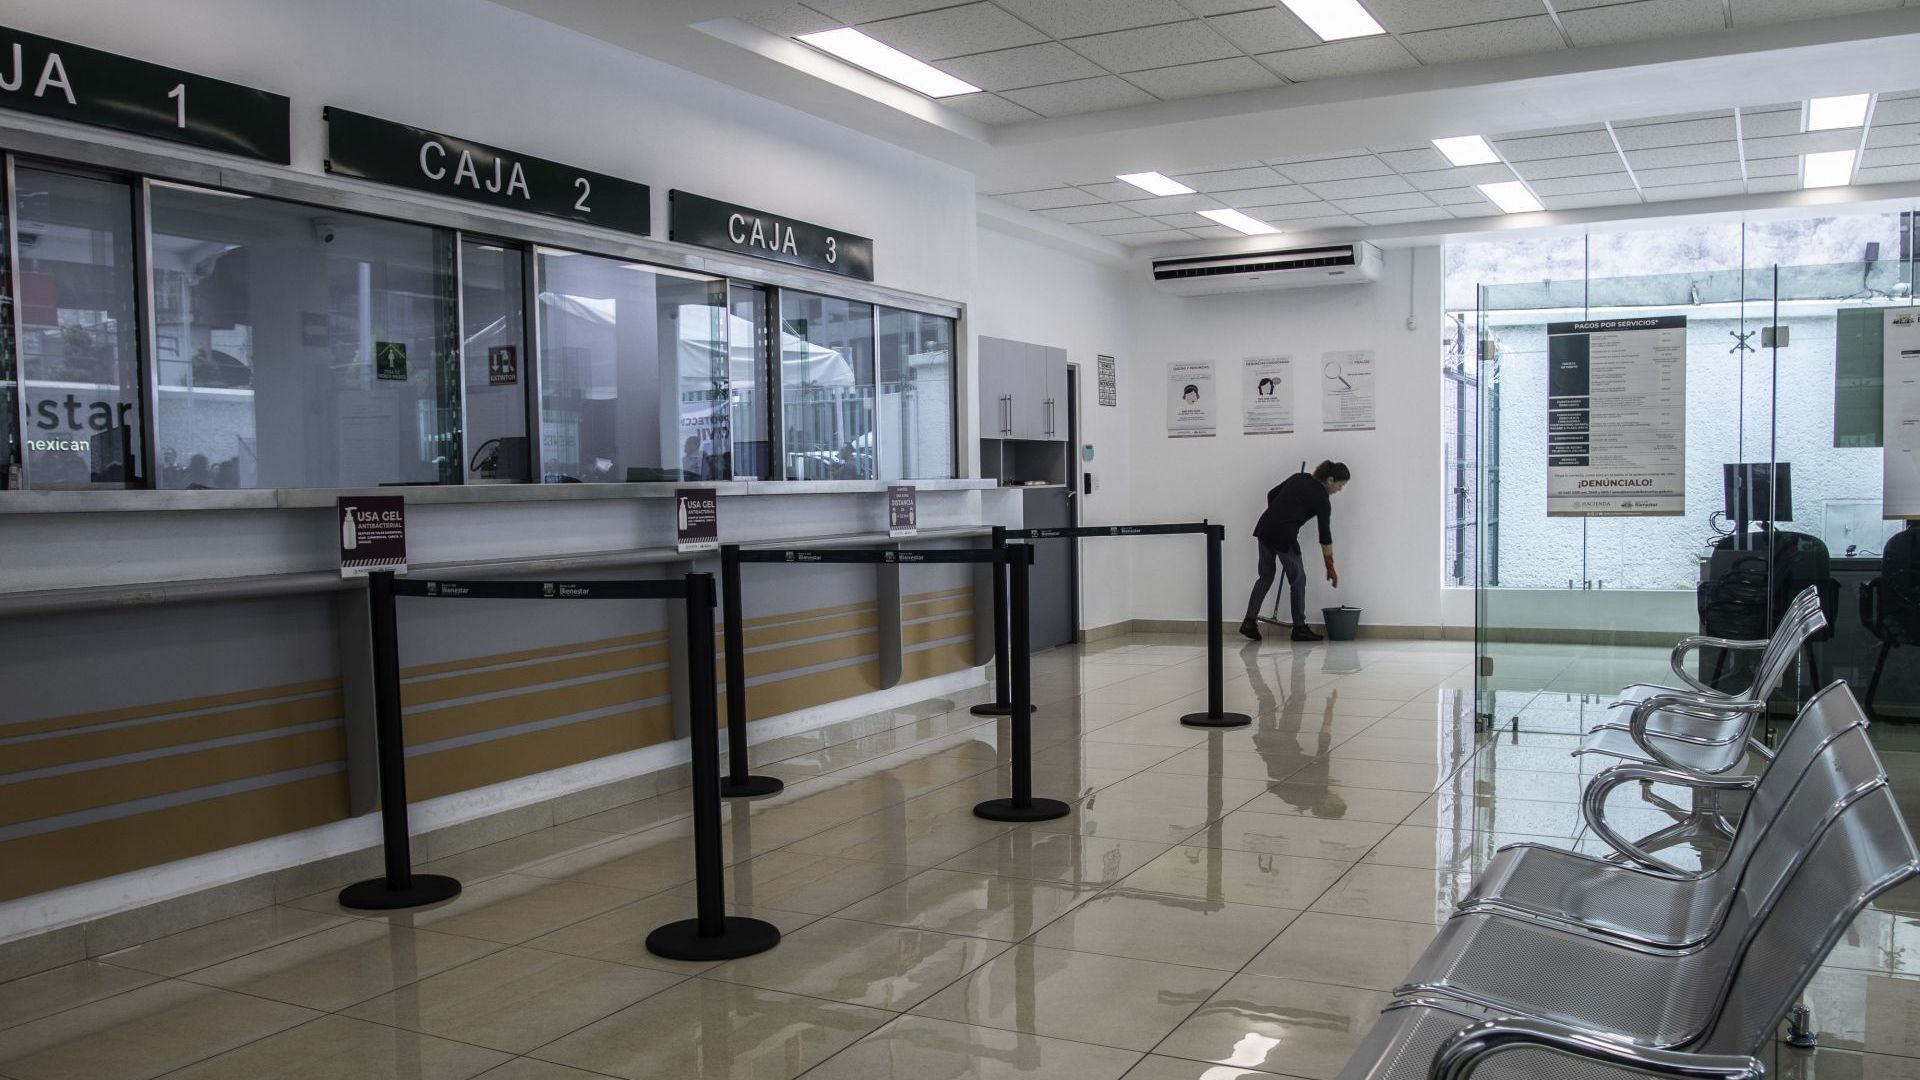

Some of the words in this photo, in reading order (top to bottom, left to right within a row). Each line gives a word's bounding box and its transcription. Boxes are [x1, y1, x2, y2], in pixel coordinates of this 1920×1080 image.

[0, 43, 77, 105] JA
[167, 83, 187, 128] 1
[419, 141, 531, 200] CAJA
[574, 177, 592, 212] 2
[728, 213, 798, 257] CAJA
[825, 236, 837, 264] 3
[1574, 322, 1600, 330] PAGOS
[1578, 477, 1653, 489] ¡DENÚNCIALO!
[687, 500, 701, 509] USA
[702, 500, 716, 508] GEL
[357, 511, 380, 521] USA
[382, 510, 403, 521] GEL
[559, 587, 590, 595] Bienestar
